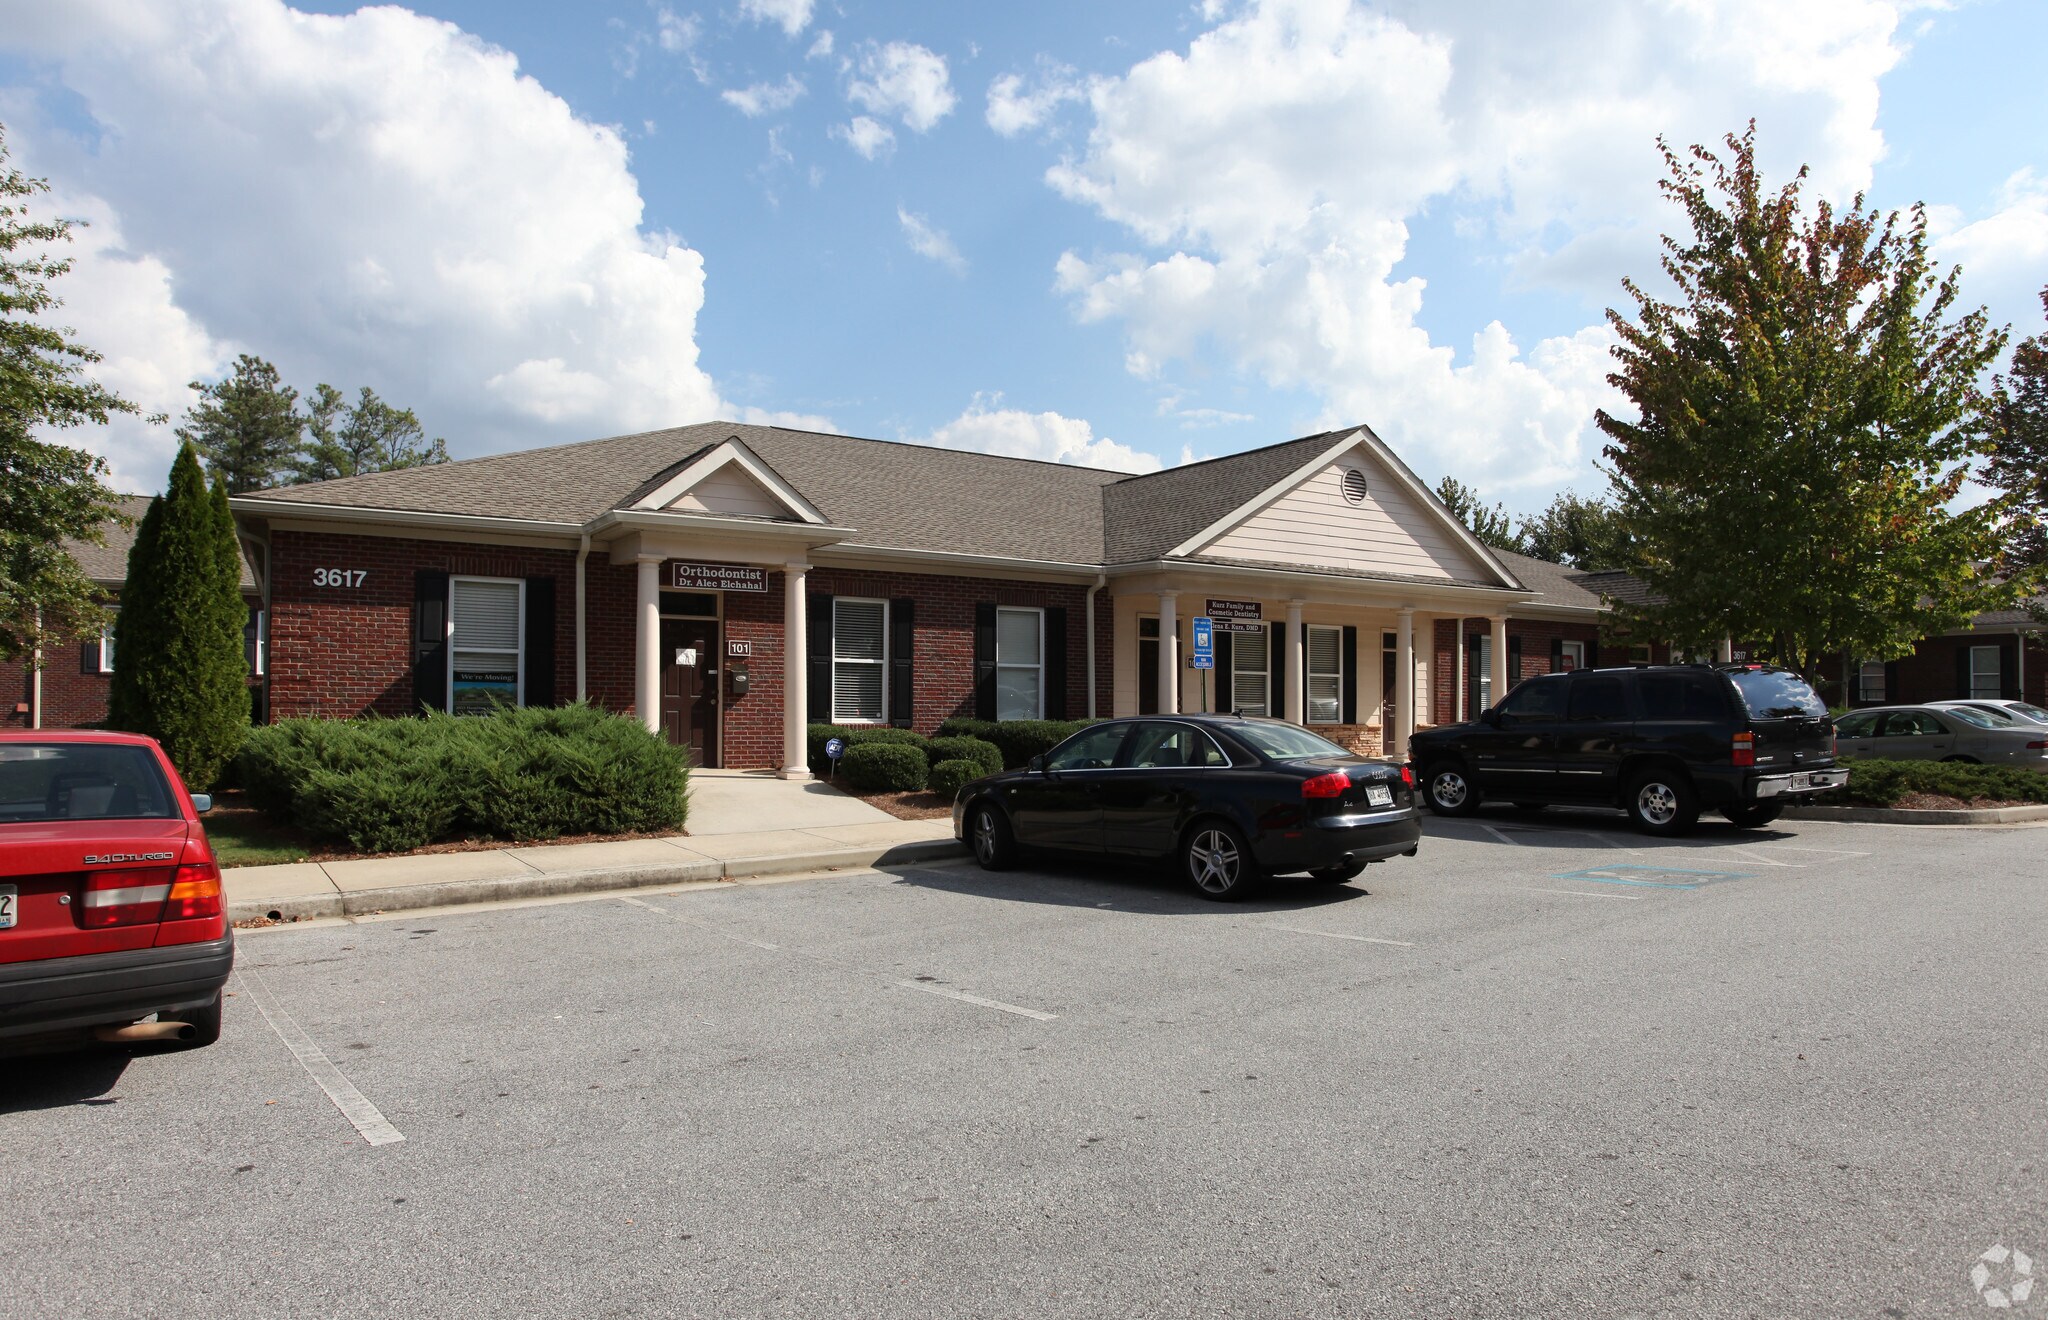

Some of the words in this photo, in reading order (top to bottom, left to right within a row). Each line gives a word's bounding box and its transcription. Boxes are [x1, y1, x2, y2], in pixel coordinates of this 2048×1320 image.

[680, 565, 762, 580] Orthodontist
[313, 568, 367, 588] 3617
[679, 578, 693, 586] Dr.
[696, 579, 718, 587] Alec
[721, 580, 762, 590] Elchahal
[1234, 610, 1260, 619] Dentistry
[1212, 622, 1223, 630] lena
[731, 643, 749, 653] 101
[1733, 651, 1746, 660] 3617
[484, 674, 514, 682] Moving!
[829, 744, 842, 752] ADT
